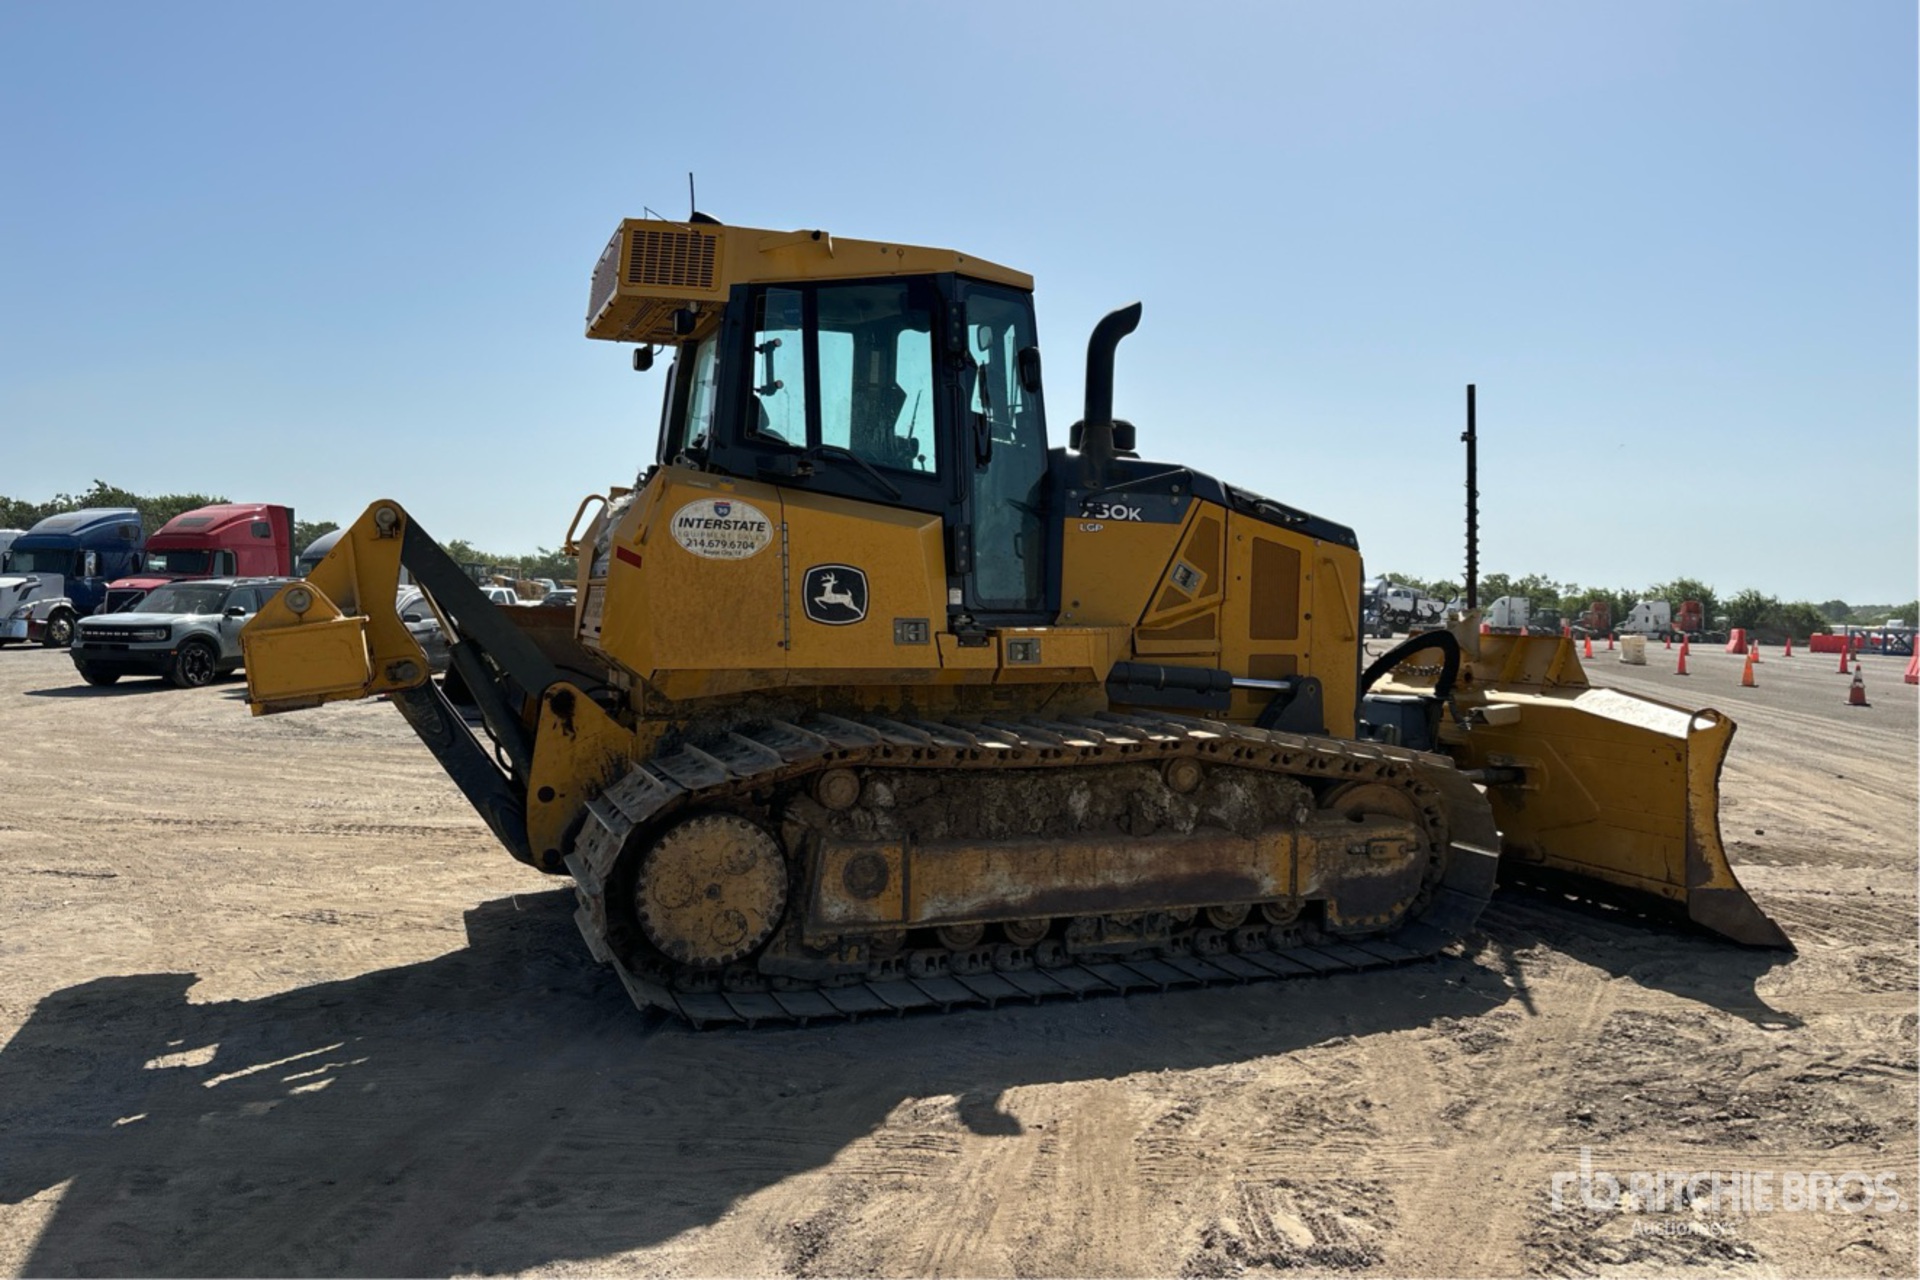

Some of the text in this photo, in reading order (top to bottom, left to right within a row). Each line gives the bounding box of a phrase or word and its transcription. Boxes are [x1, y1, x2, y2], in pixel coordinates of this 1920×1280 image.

[678, 517, 766, 532] INTERSTATE
[1079, 523, 1103, 532] LGP
[685, 538, 755, 550] 214.679.6704
